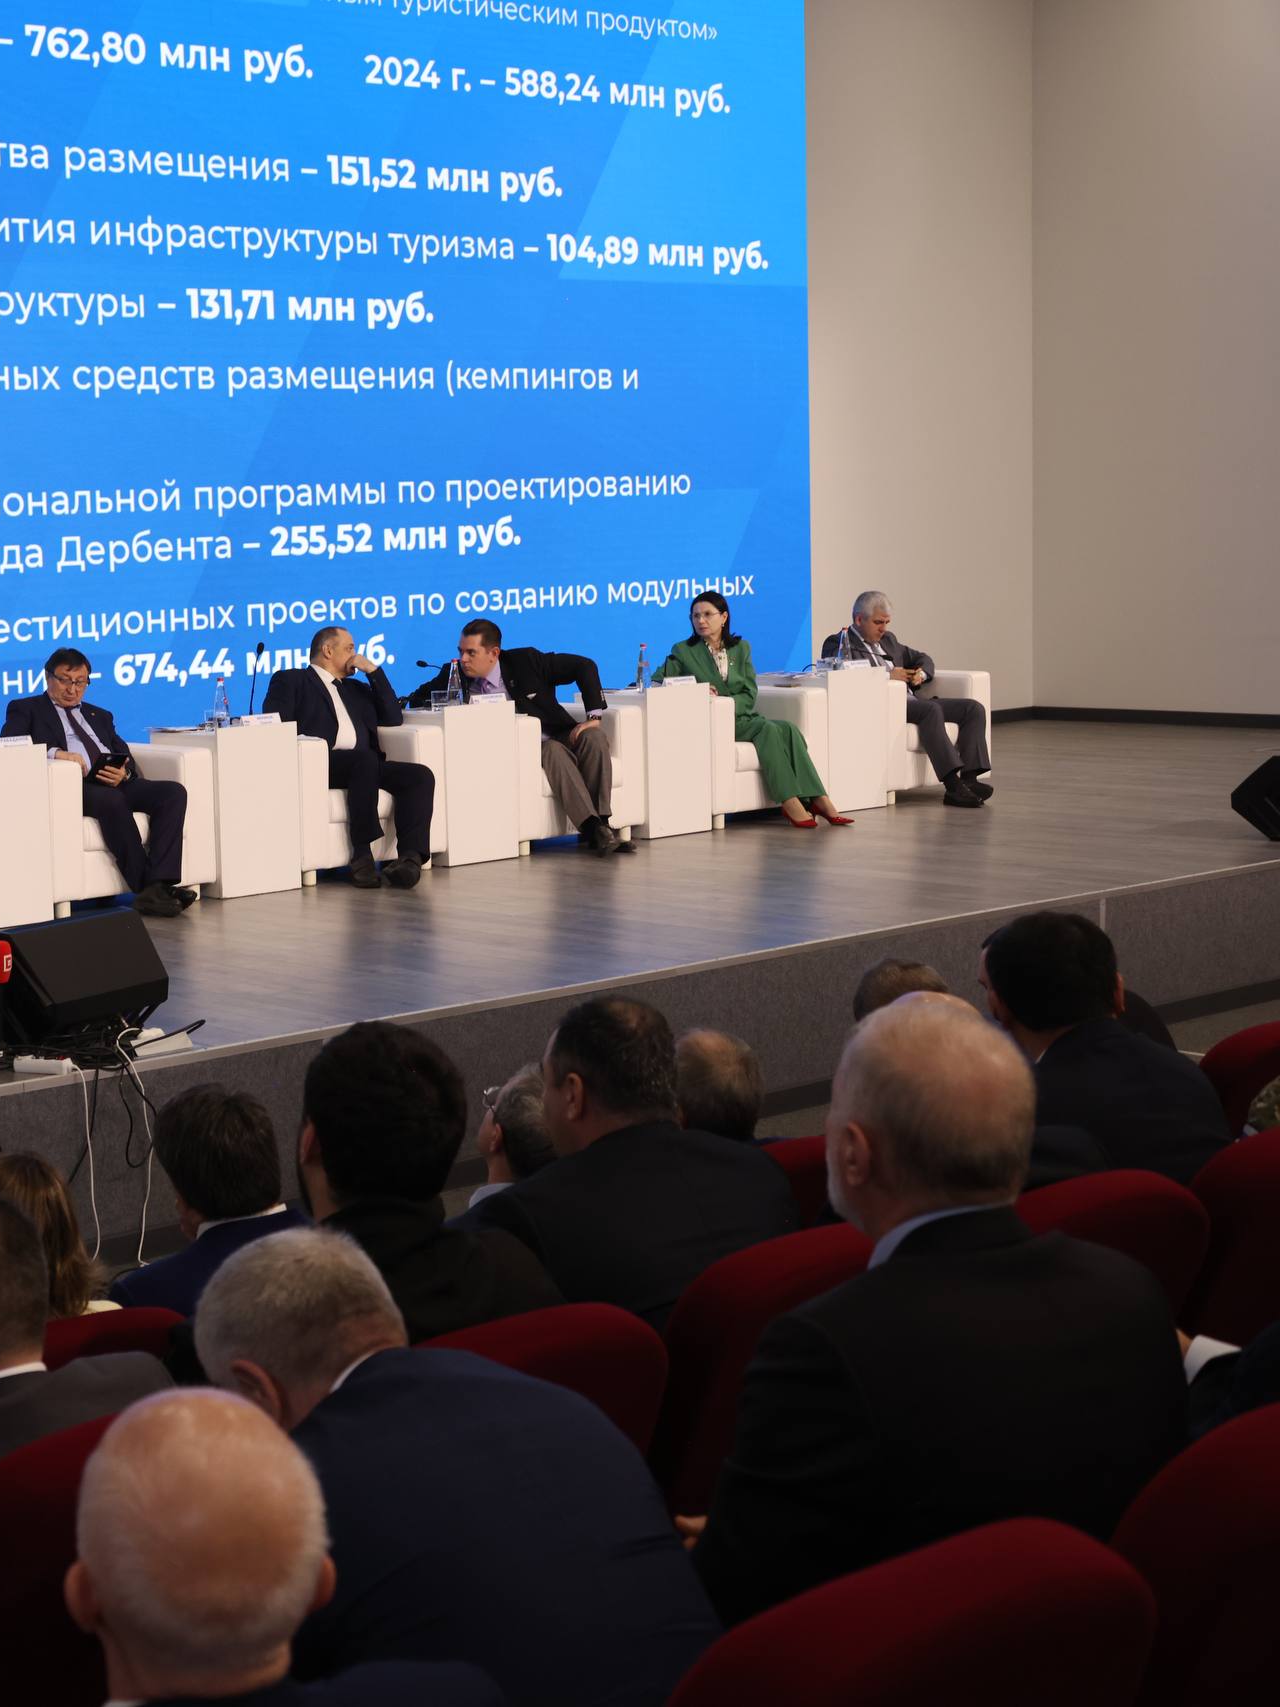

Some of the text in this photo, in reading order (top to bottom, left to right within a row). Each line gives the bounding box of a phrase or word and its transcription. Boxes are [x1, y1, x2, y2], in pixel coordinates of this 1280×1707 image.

[24, 24, 147, 68] 762,80
[159, 42, 231, 72] млн
[244, 43, 314, 84] руб.
[586, 11, 718, 41] продуктом»
[364, 54, 441, 89] 2024
[451, 67, 472, 92] г.
[504, 66, 601, 106] 588,24
[609, 82, 665, 109] млн
[674, 82, 731, 119] руб.
[64, 146, 290, 182] размещения
[326, 154, 417, 193] 151,52
[427, 166, 490, 193] млн
[500, 165, 563, 203] руб.
[90, 215, 378, 261] инфраструктуры
[387, 232, 515, 264] туризма
[546, 233, 640, 269] 104,89
[648, 243, 704, 268] млн
[713, 240, 769, 276] руб.
[185, 287, 275, 326] 131,71
[287, 296, 355, 321] млн
[367, 290, 434, 330] руб.
[72, 365, 216, 399] средств
[227, 366, 435, 398] размещения
[446, 359, 613, 397] (кемпингов
[623, 368, 639, 390] и
[194, 481, 386, 518] программы
[398, 480, 436, 504] по
[445, 474, 691, 509] проектированию
[56, 529, 232, 573] Дербента
[270, 522, 373, 560] 255,52
[383, 525, 447, 552] млн
[458, 514, 522, 556] руб.
[247, 595, 398, 633] проектов
[408, 592, 445, 617] по
[455, 580, 599, 615] созданию
[606, 575, 755, 608] модульных
[113, 647, 235, 688] 674,44
[246, 646, 312, 676] млн
